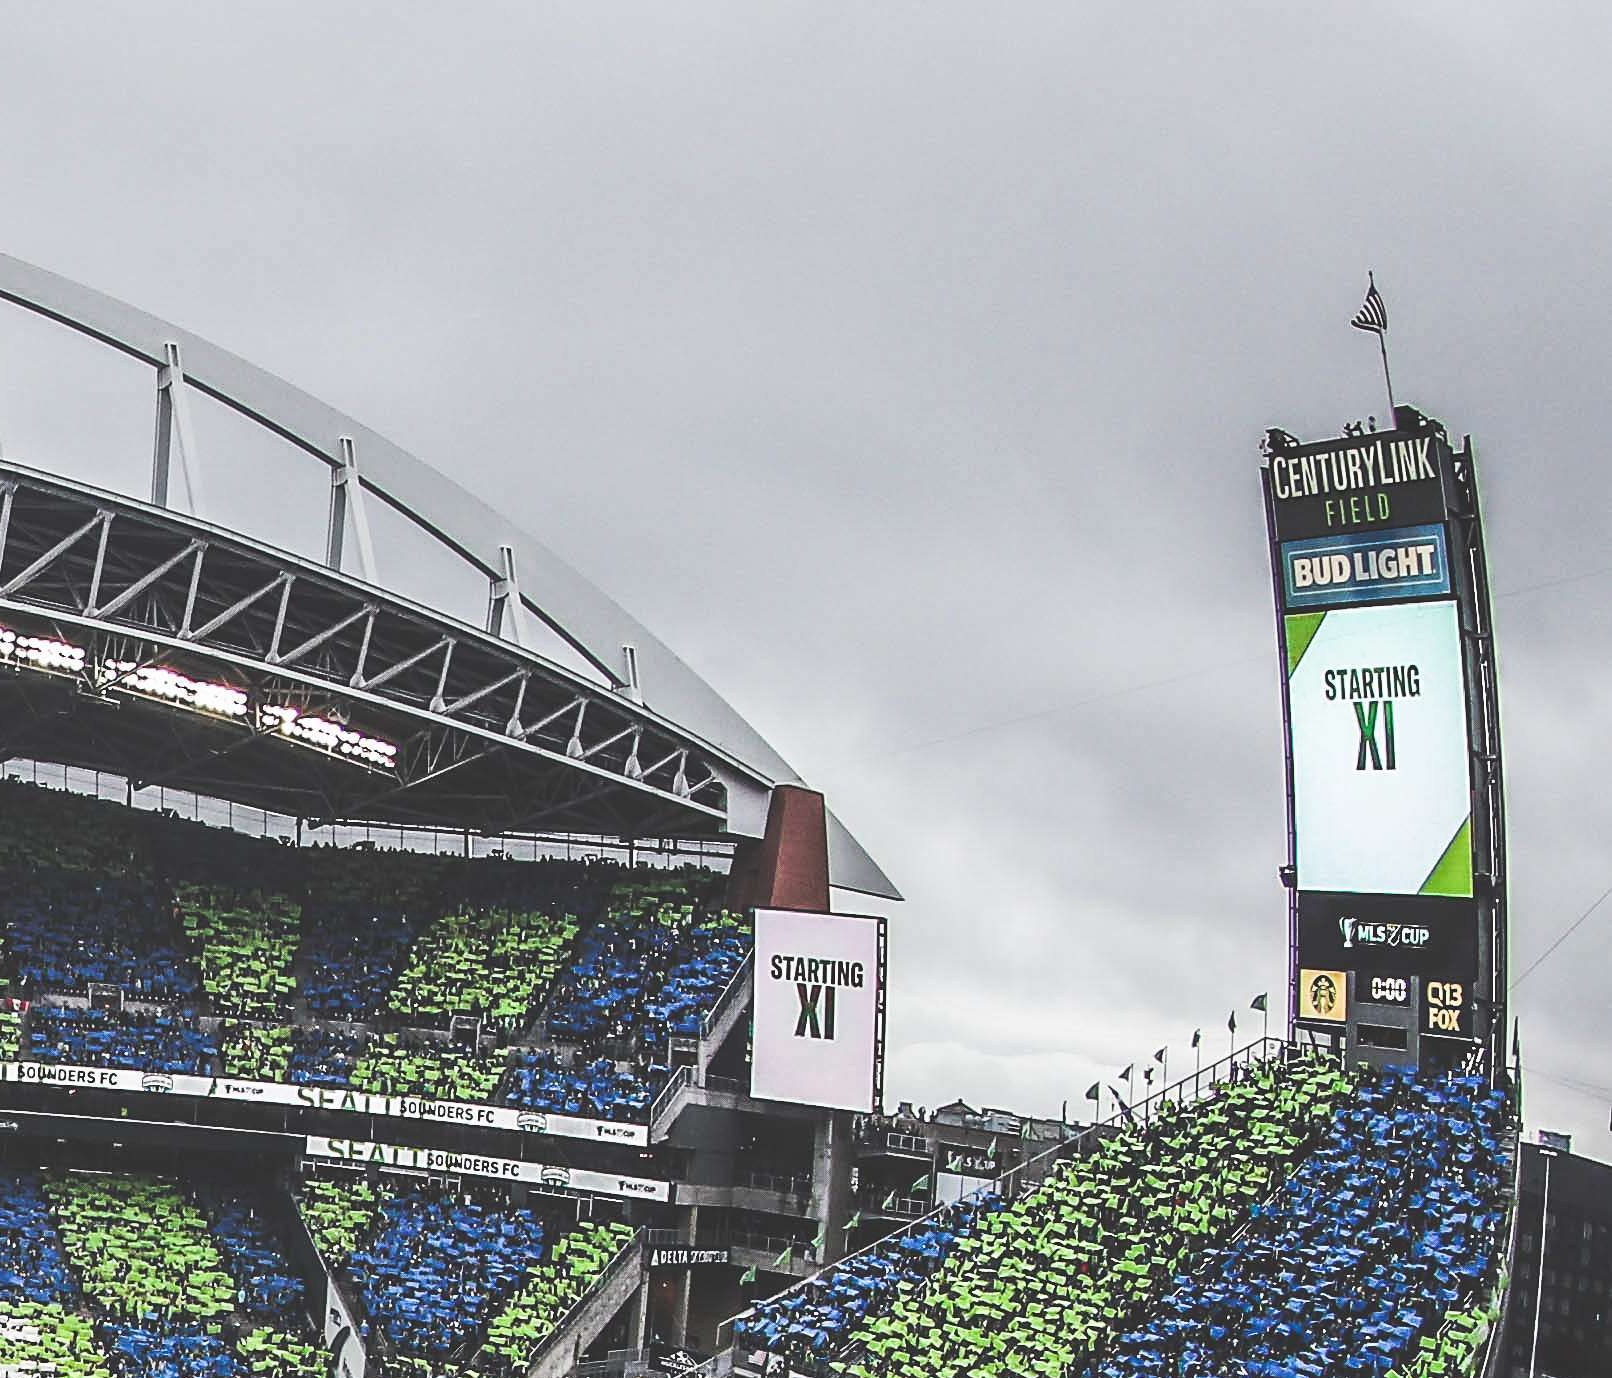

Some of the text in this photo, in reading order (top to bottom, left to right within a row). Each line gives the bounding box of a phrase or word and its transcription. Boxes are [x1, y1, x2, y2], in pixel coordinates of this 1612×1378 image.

[1273, 437, 1436, 499] CENTURYLINK
[1326, 493, 1390, 527] FIELD
[1293, 545, 1436, 588] BUD LIGHT
[1324, 664, 1421, 700] STARTING
[1353, 700, 1396, 771] XI
[1358, 925, 1429, 945] MLS CUP
[770, 955, 864, 988] STARTING
[1371, 977, 1407, 1002] 0:00
[1427, 981, 1463, 1007] Q13
[794, 982, 836, 1041] XI
[1429, 1007, 1460, 1032] FOX
[17, 1065, 118, 1086] SOUNDERS FC
[399, 1100, 495, 1124] SOUNDERS FC
[427, 1152, 520, 1177] SOUNDERS FC
[661, 1250, 688, 1265] DELTA
